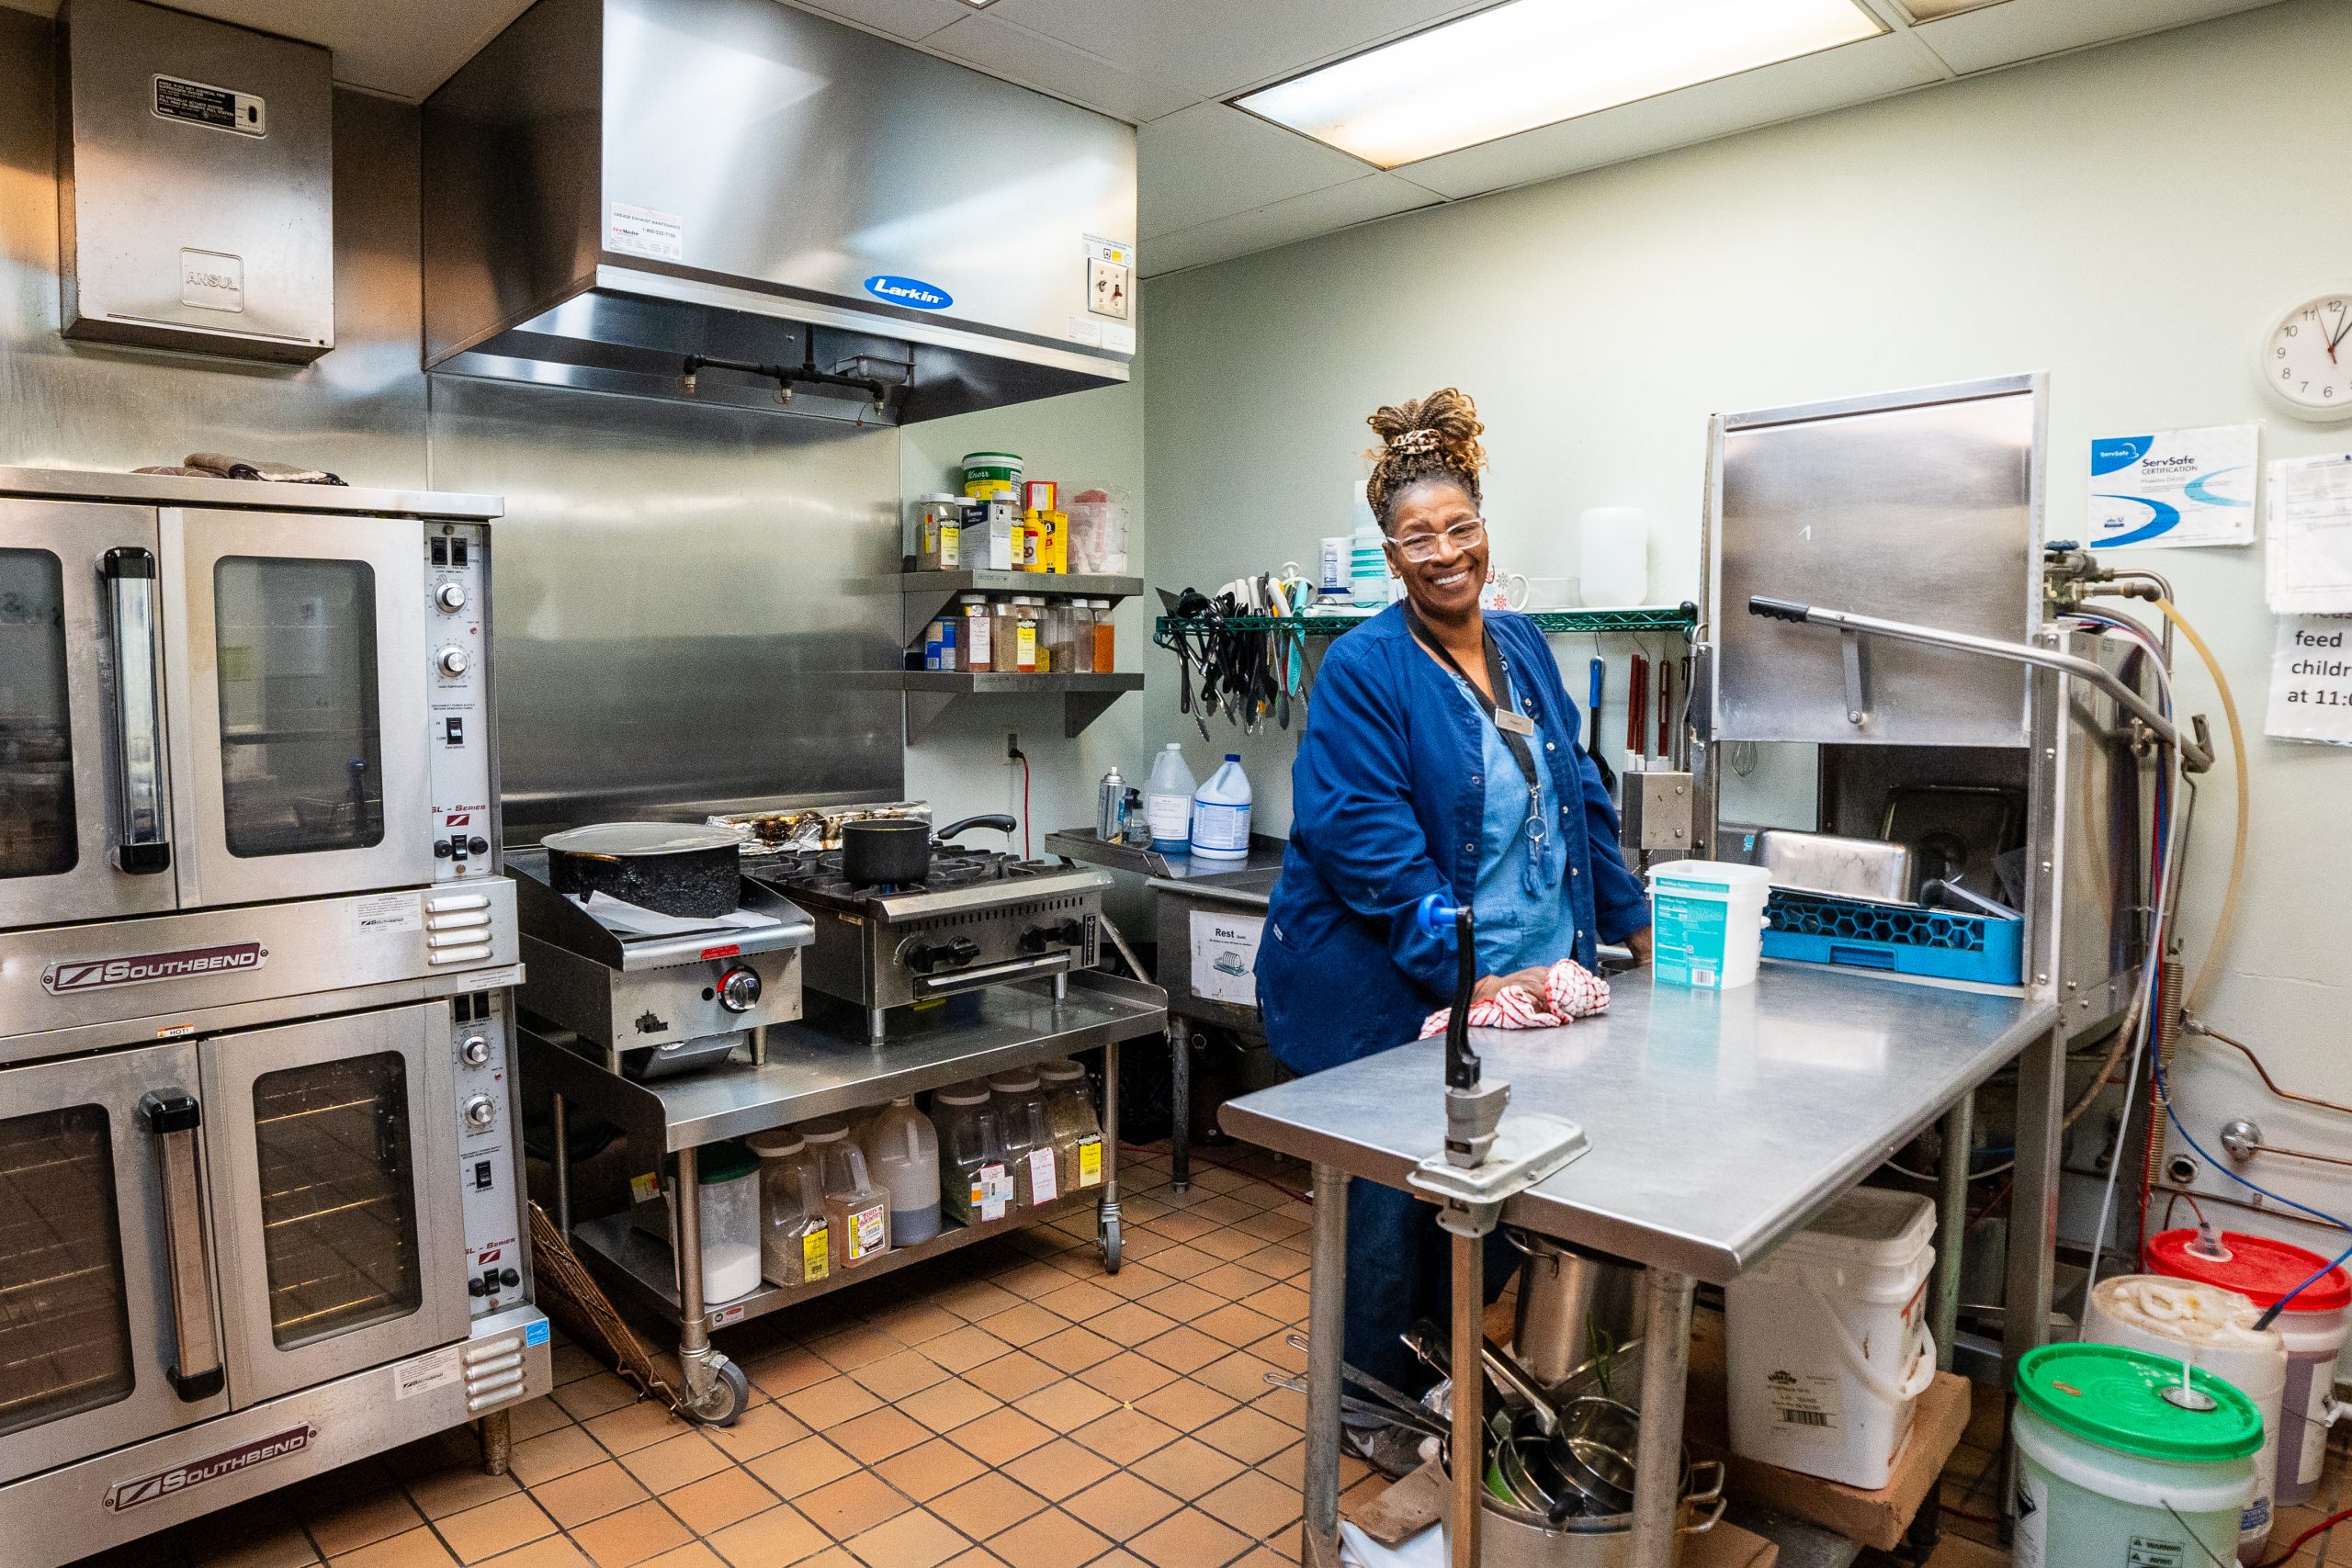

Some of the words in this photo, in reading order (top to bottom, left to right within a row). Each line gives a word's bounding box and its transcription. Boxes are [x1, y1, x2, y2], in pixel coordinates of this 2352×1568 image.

[652, 220, 680, 230] MAINTENANCE
[186, 272, 239, 290] ANSUL
[875, 278, 939, 303] Larkin
[2328, 300, 2342, 311] 12
[2303, 310, 2315, 321] 11
[2284, 325, 2298, 337] 10
[2278, 347, 2285, 358] 9
[2282, 367, 2290, 379] 8
[2301, 381, 2309, 393] 7
[2324, 386, 2333, 398] 6
[2143, 456, 2195, 467] ServSafe
[968, 470, 989, 479] Knorr
[2142, 466, 2198, 475] CERTIFICATION
[2295, 630, 2343, 648] feed
[2288, 690, 2308, 703] at
[1216, 928, 1235, 938] Rest
[104, 953, 255, 982] SOUTHBEND
[487, 1238, 514, 1248] SERIES
[163, 1435, 305, 1493] SOUTHBEND
[2146, 1541, 2182, 1552] WARNING
